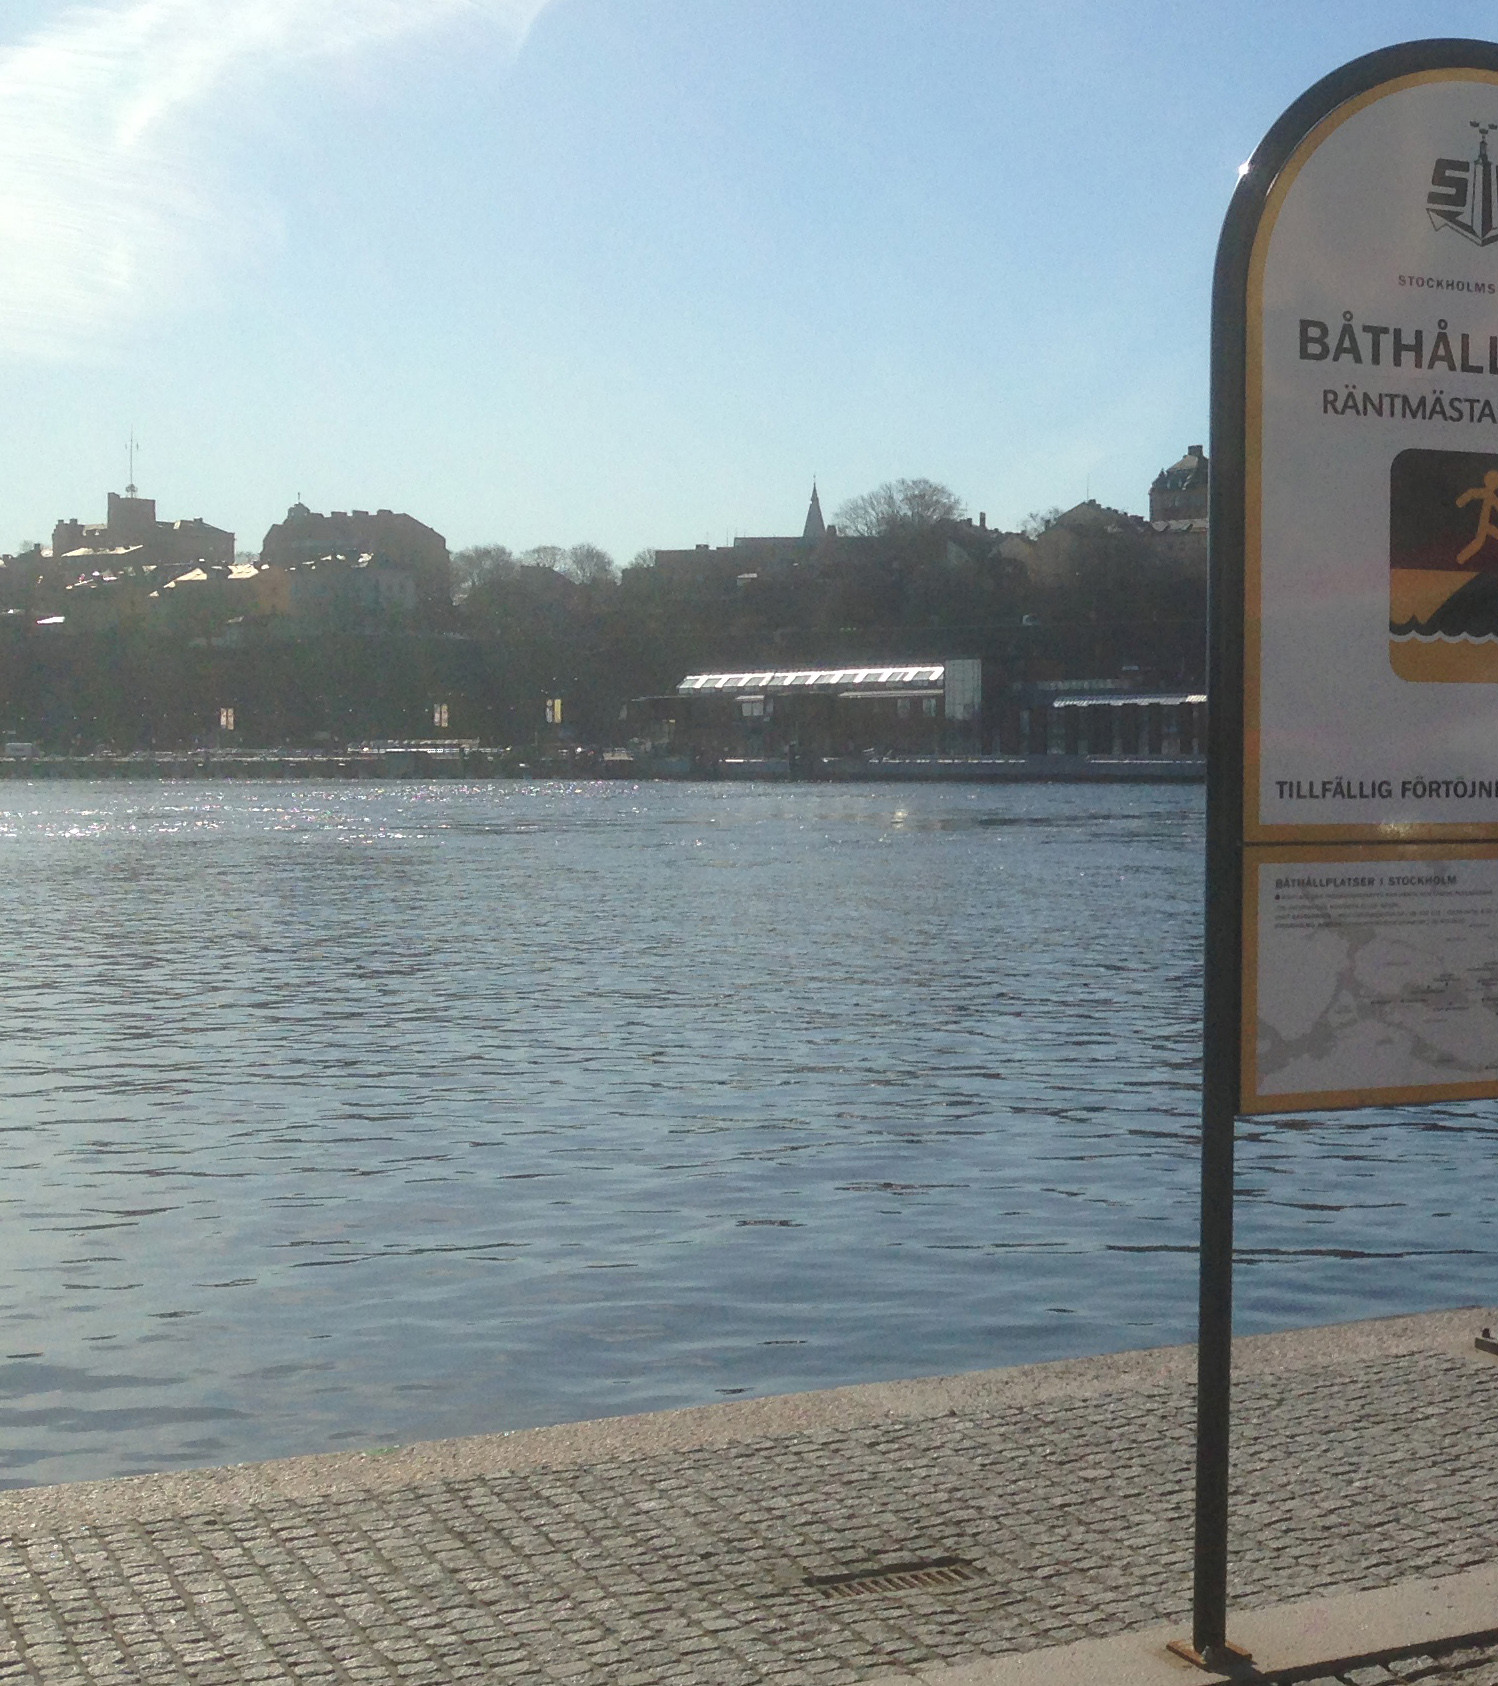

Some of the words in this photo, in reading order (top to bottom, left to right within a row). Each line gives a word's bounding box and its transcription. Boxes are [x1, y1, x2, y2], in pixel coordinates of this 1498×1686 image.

[1398, 274, 1496, 294] STOCKHOLMS
[1275, 776, 1393, 799] TILLFÄLLIG
[1275, 876, 1376, 889] BÅTHÅLLPLATSER
[1388, 875, 1457, 887] STOCKHOLM
